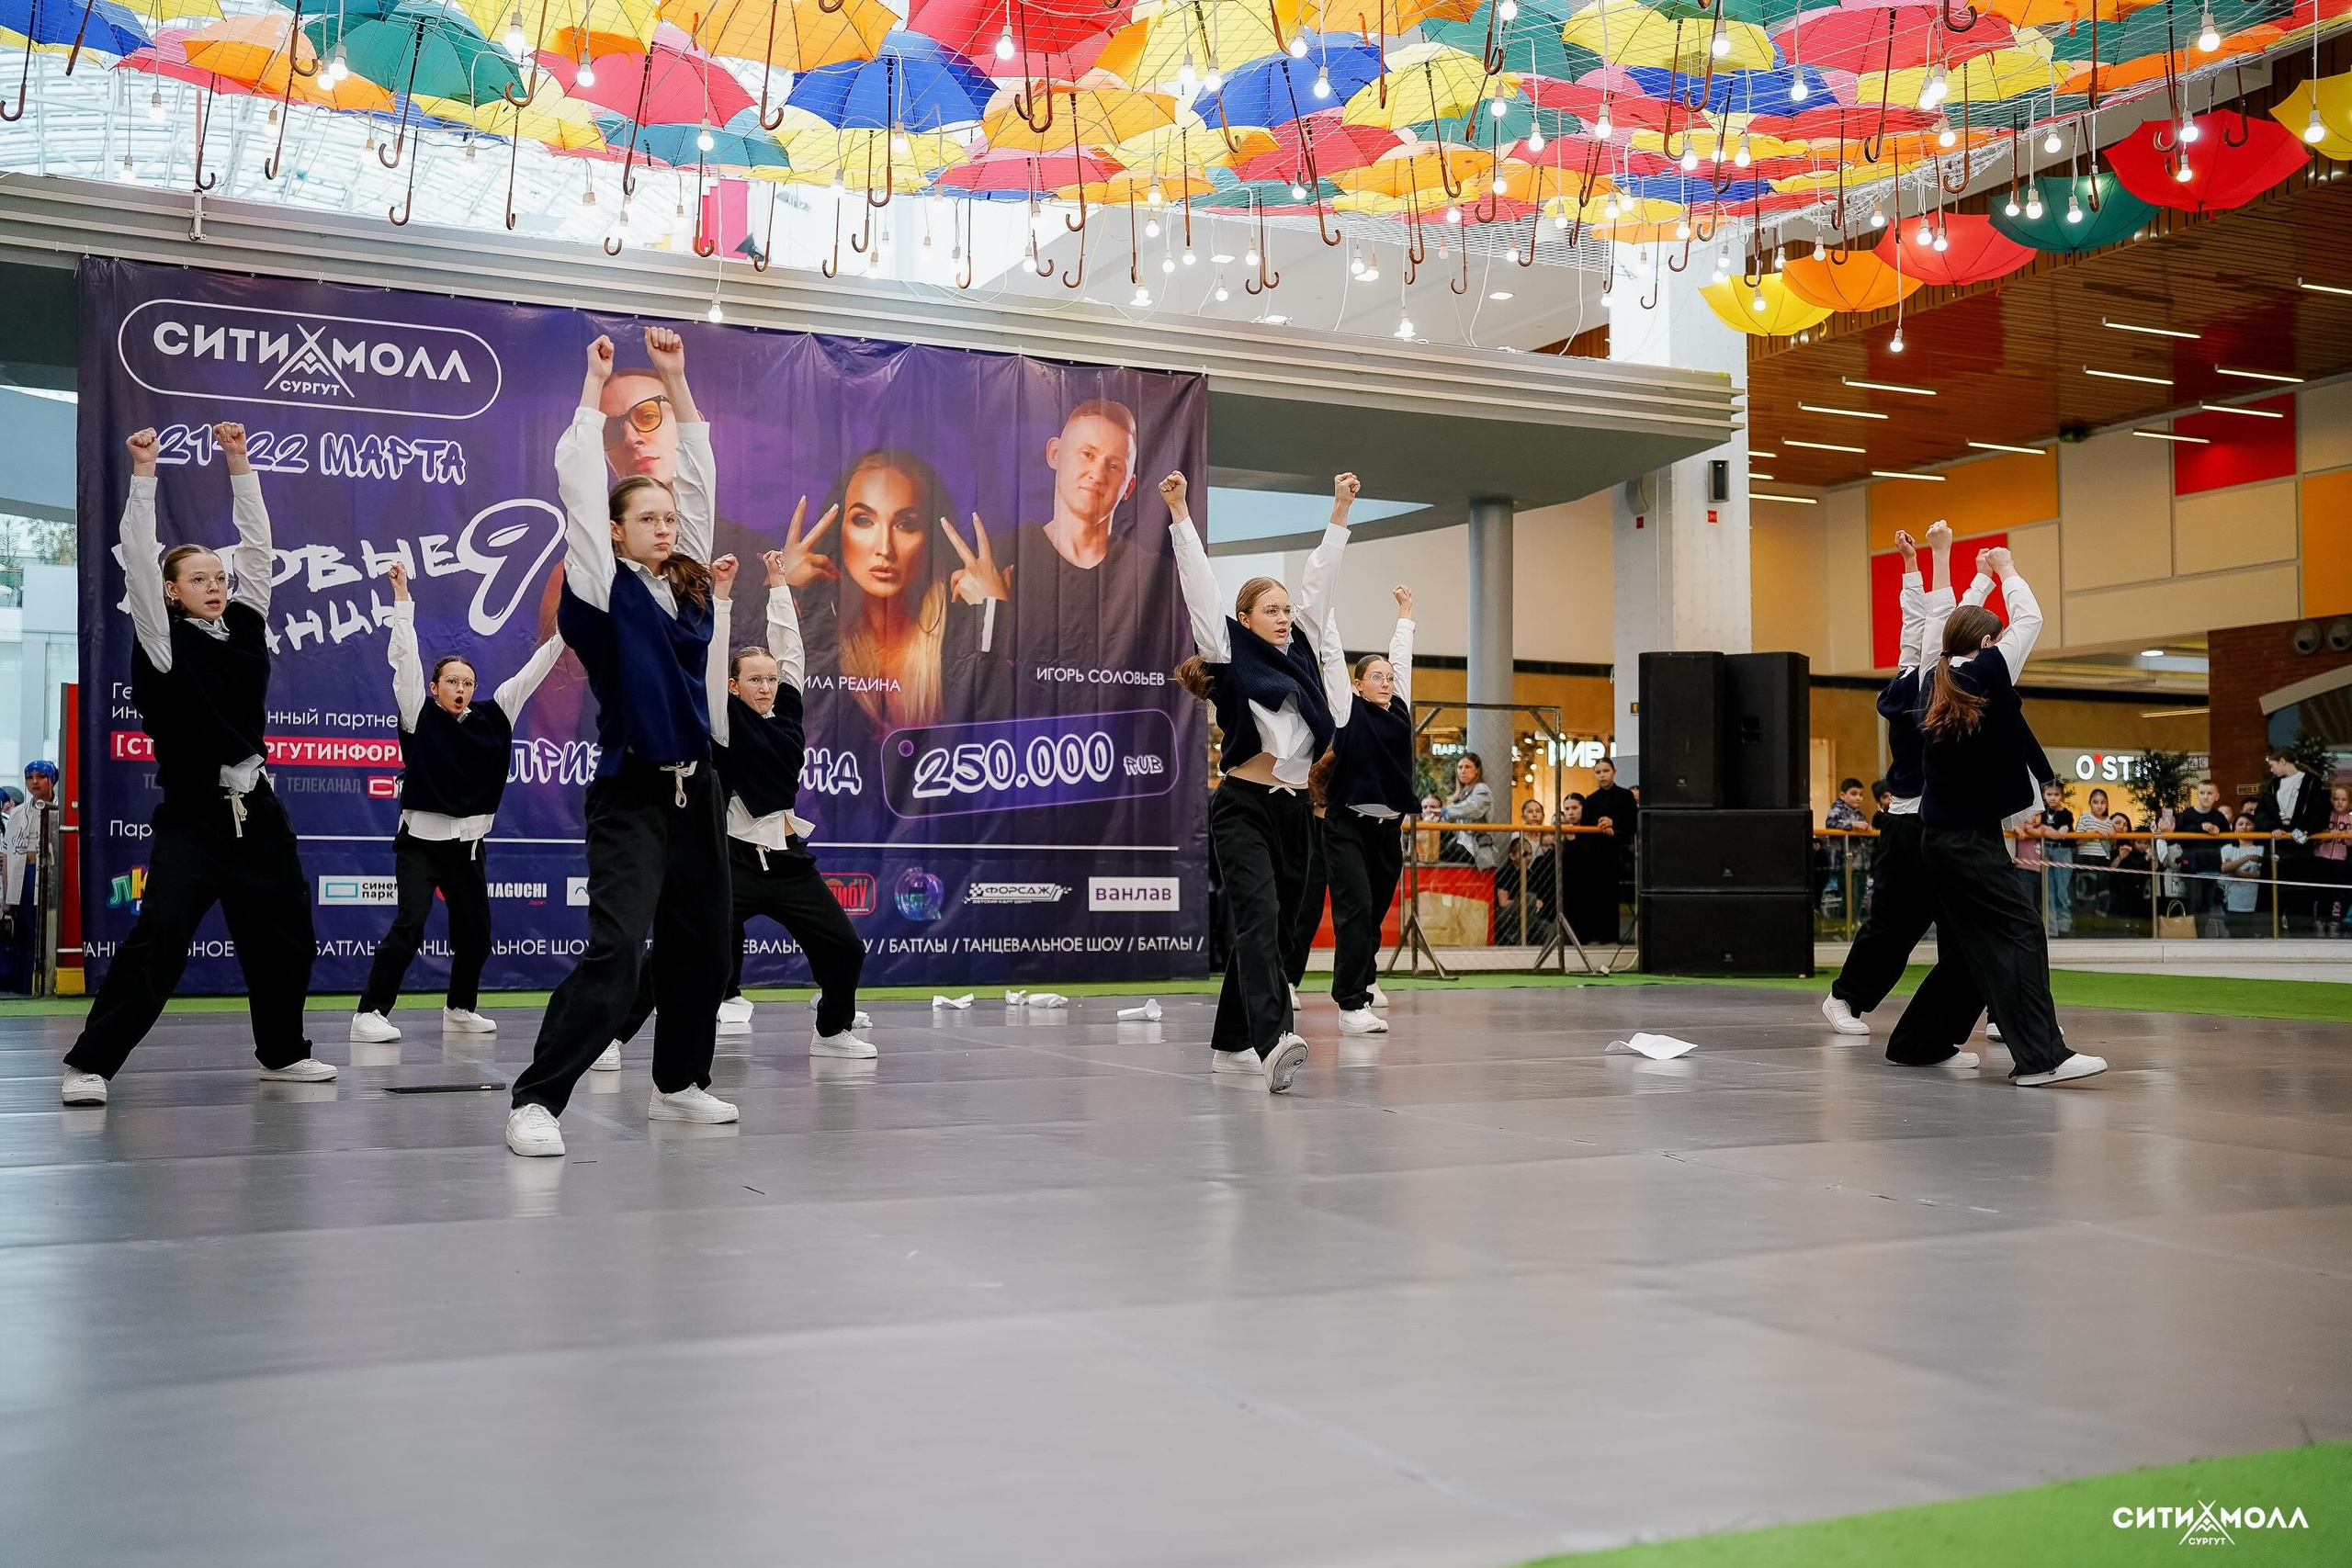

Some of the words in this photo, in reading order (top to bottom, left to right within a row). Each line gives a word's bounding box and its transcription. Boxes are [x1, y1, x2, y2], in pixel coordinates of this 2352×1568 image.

[153, 321, 288, 365] СИТИ
[279, 379, 340, 397] СУРГУТ
[321, 432, 467, 486] МАРТА
[803, 675, 834, 690] ИЛА
[838, 676, 901, 693] РЕДИНА
[1036, 667, 1084, 682] ИГОРЬ
[1088, 669, 1165, 686] СОЛОВЬЕВ
[325, 712, 398, 730] партне
[267, 741, 402, 761] РГУТИНФОР
[912, 731, 1114, 798] 250.000
[1123, 754, 1164, 776] RUB
[287, 776, 361, 794] ТЕЛЕКАНАЛ
[362, 882, 398, 890] сине
[487, 883, 548, 897] MAGUCHI
[985, 886, 1051, 896] ФОРСАЖ
[1095, 886, 1172, 901] ванлав
[362, 891, 394, 901] парк
[889, 939, 947, 953] БАТТЛЫ
[963, 937, 1083, 953] ТАНЦЕВАЛЬНОЕ
[1086, 937, 1125, 952] ШОУ
[1137, 936, 1193, 952] БАТТЛЫ
